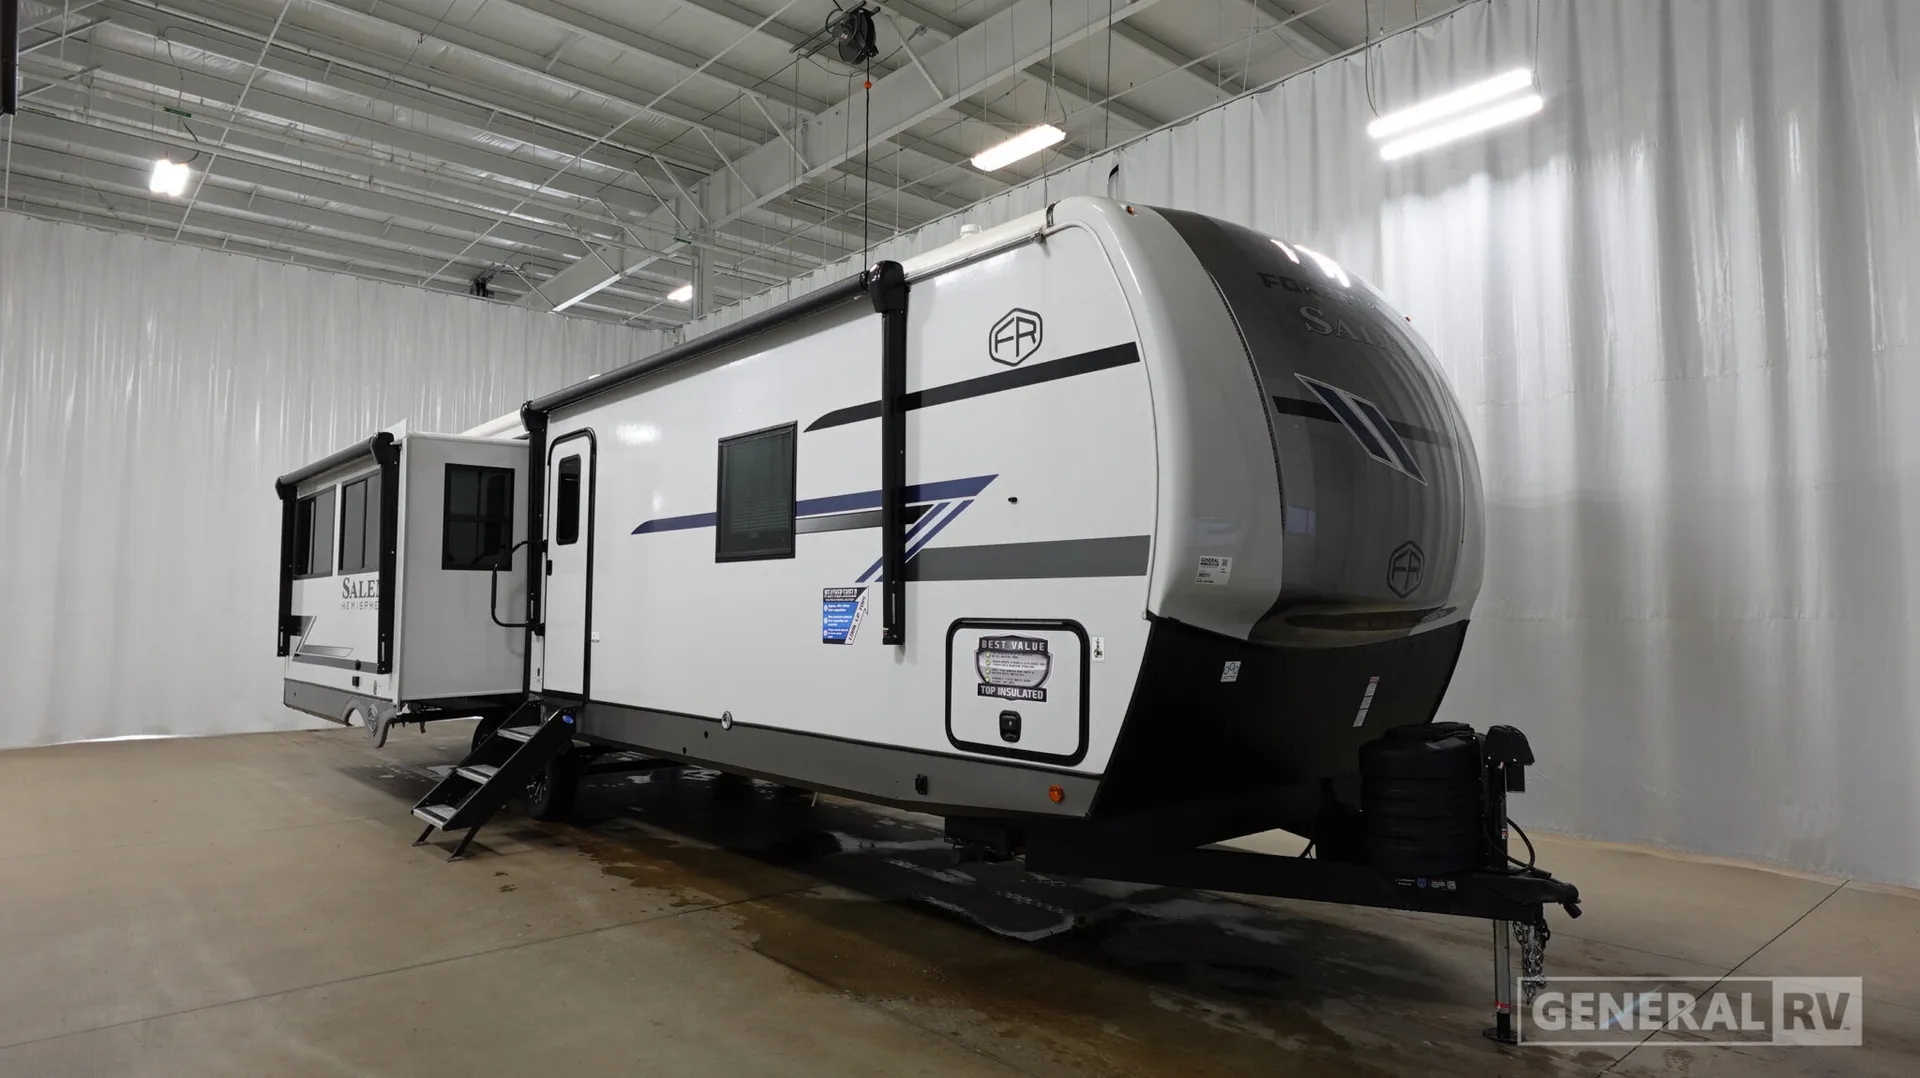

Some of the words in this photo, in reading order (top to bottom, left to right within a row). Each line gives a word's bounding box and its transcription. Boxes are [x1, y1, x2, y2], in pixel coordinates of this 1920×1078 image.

[342, 577, 379, 599] SALE
[981, 640, 1006, 649] BEST
[1011, 641, 1045, 651] VALUE
[980, 685, 996, 695] TOP
[997, 687, 1044, 700] INSULATED
